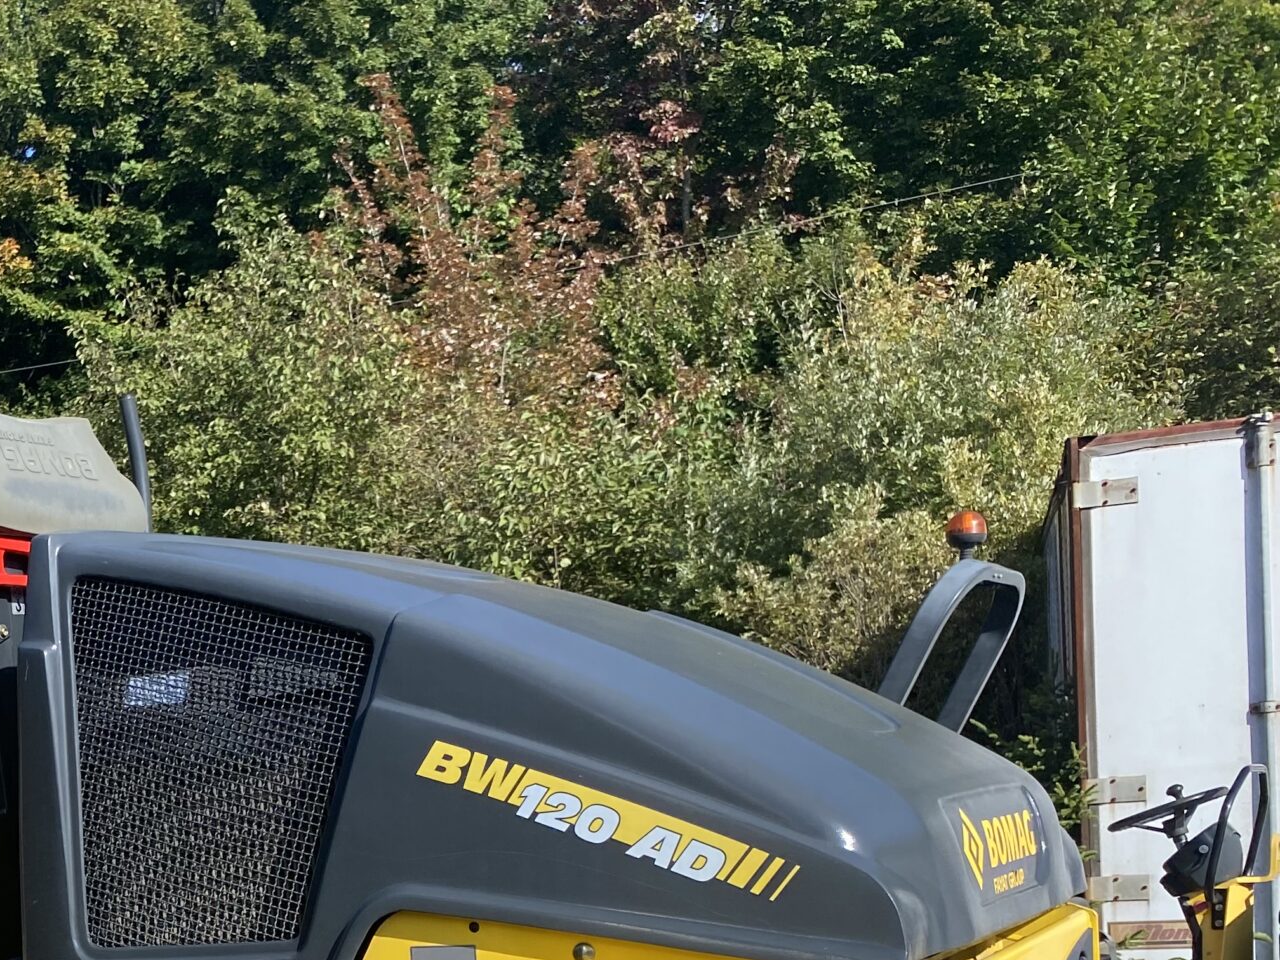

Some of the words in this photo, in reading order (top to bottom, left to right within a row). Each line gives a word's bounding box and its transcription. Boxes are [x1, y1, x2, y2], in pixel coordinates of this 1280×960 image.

[0, 443, 100, 482] BOMAG
[624, 825, 726, 882] AD
[981, 809, 1037, 869] BOMAG
